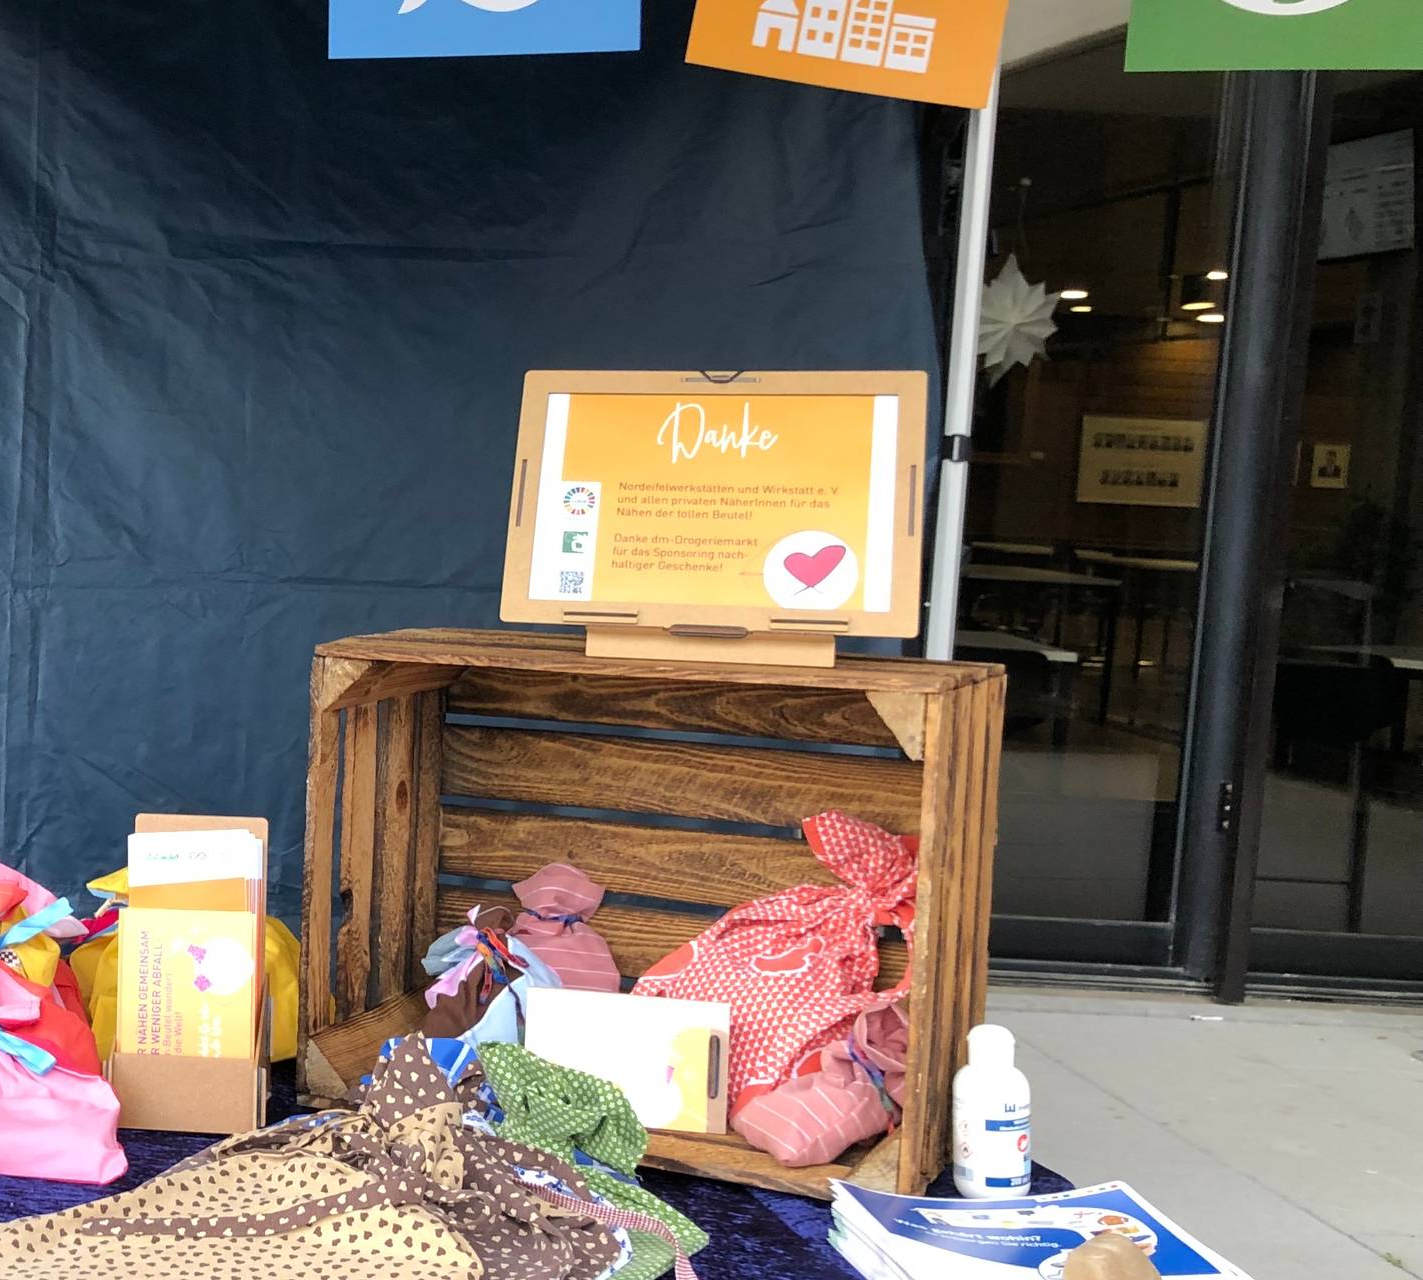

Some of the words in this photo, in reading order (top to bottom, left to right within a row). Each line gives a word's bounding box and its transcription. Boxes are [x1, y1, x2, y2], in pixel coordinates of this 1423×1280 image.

[657, 402, 778, 464] Danke
[738, 485, 759, 494] und
[762, 485, 814, 495] Wirkstatt
[617, 495, 637, 504] und
[641, 495, 668, 504] allen
[671, 497, 716, 507] privaten
[790, 498, 807, 508] für
[809, 499, 830, 509] das
[617, 507, 652, 517] Nähen
[656, 508, 673, 518] der
[677, 509, 708, 519] tollen
[712, 509, 752, 520] Beutel!
[614, 532, 648, 543] Danke
[651, 534, 758, 547] dm-Drogeriemarkt
[612, 546, 628, 556] für
[631, 547, 650, 557] das
[653, 548, 714, 560] Sponsoring
[718, 550, 748, 559] nach-
[611, 560, 655, 571] haltiger
[658, 561, 723, 572] Geschenke!
[138, 930, 150, 1000] GEMEINSAM
[152, 944, 163, 987] ABFALL
[151, 990, 162, 1044] WENIGER
[163, 1015, 172, 1047] Beutel
[174, 1037, 182, 1054] die
